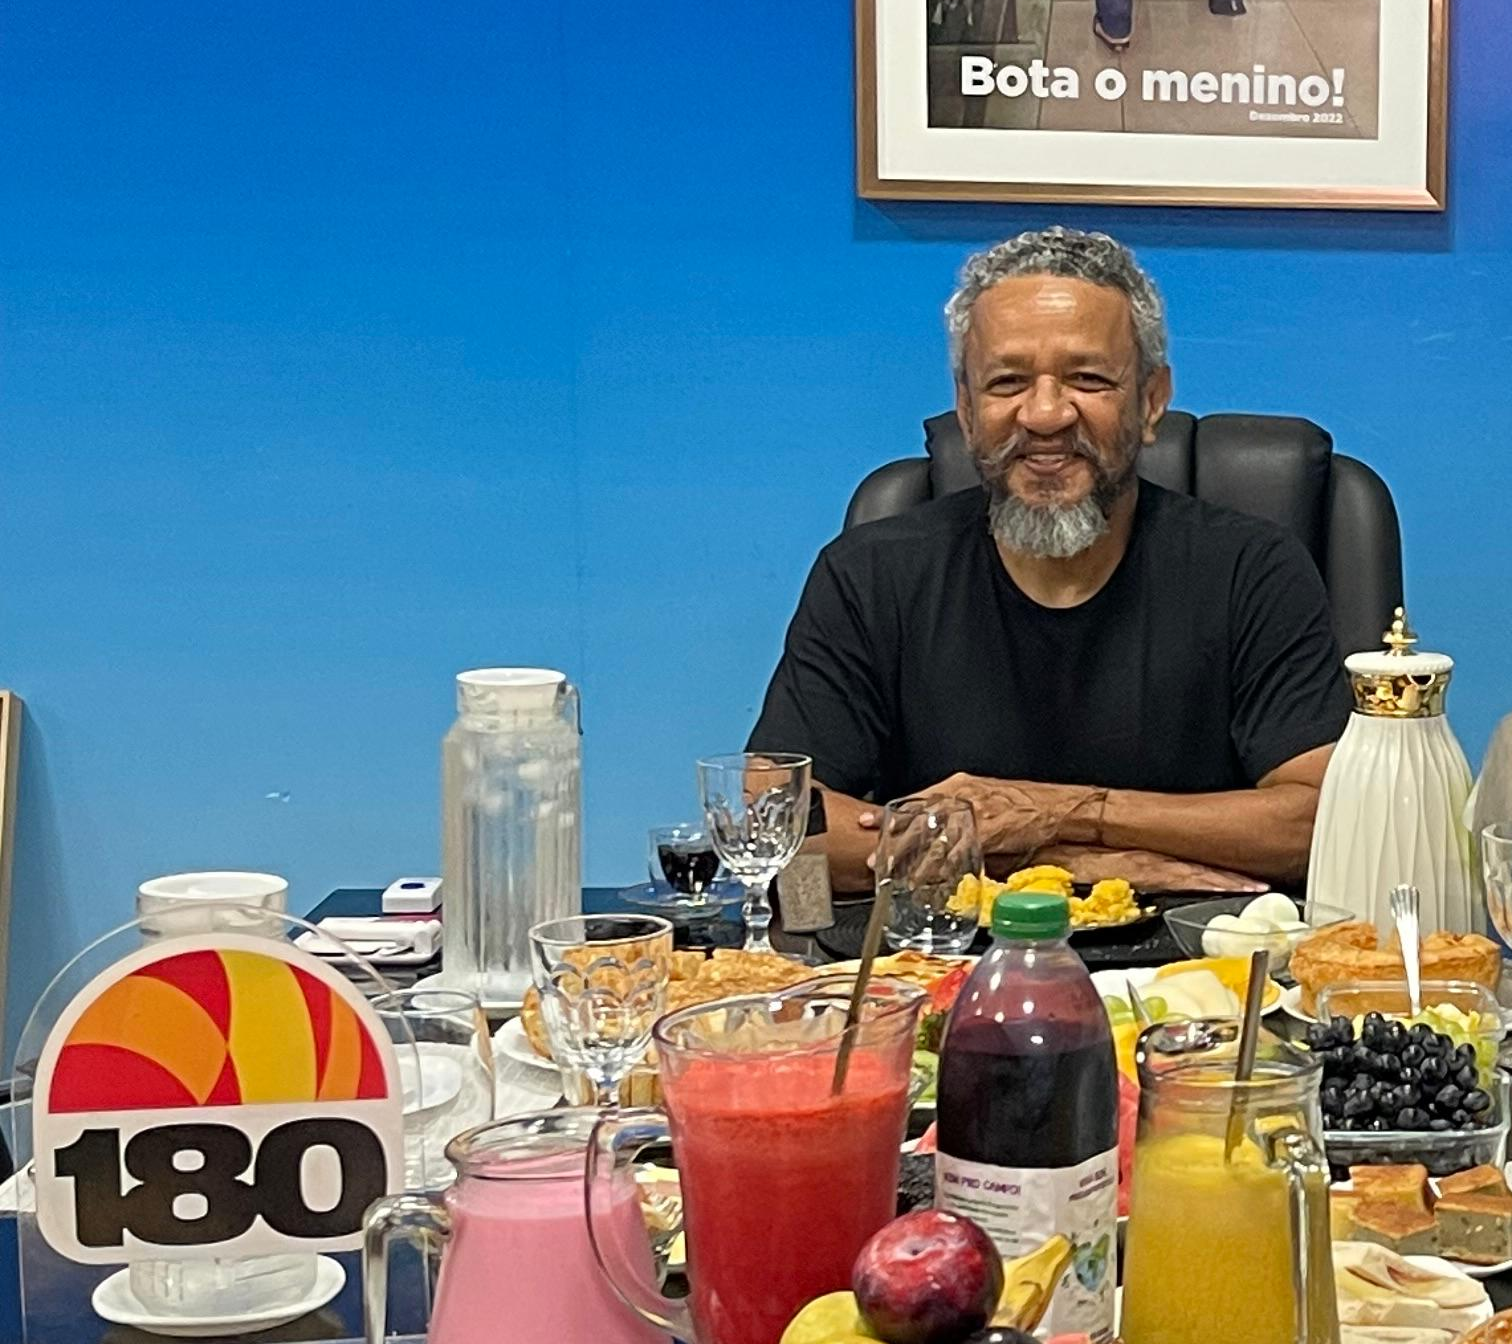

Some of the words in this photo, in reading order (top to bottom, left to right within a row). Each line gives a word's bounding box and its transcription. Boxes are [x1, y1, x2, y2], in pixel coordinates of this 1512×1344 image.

[961, 56, 1079, 99] Bota
[1094, 67, 1128, 101] o
[1142, 64, 1345, 108] menino!
[1312, 112, 1344, 124] 2022
[54, 1117, 388, 1248] 180
